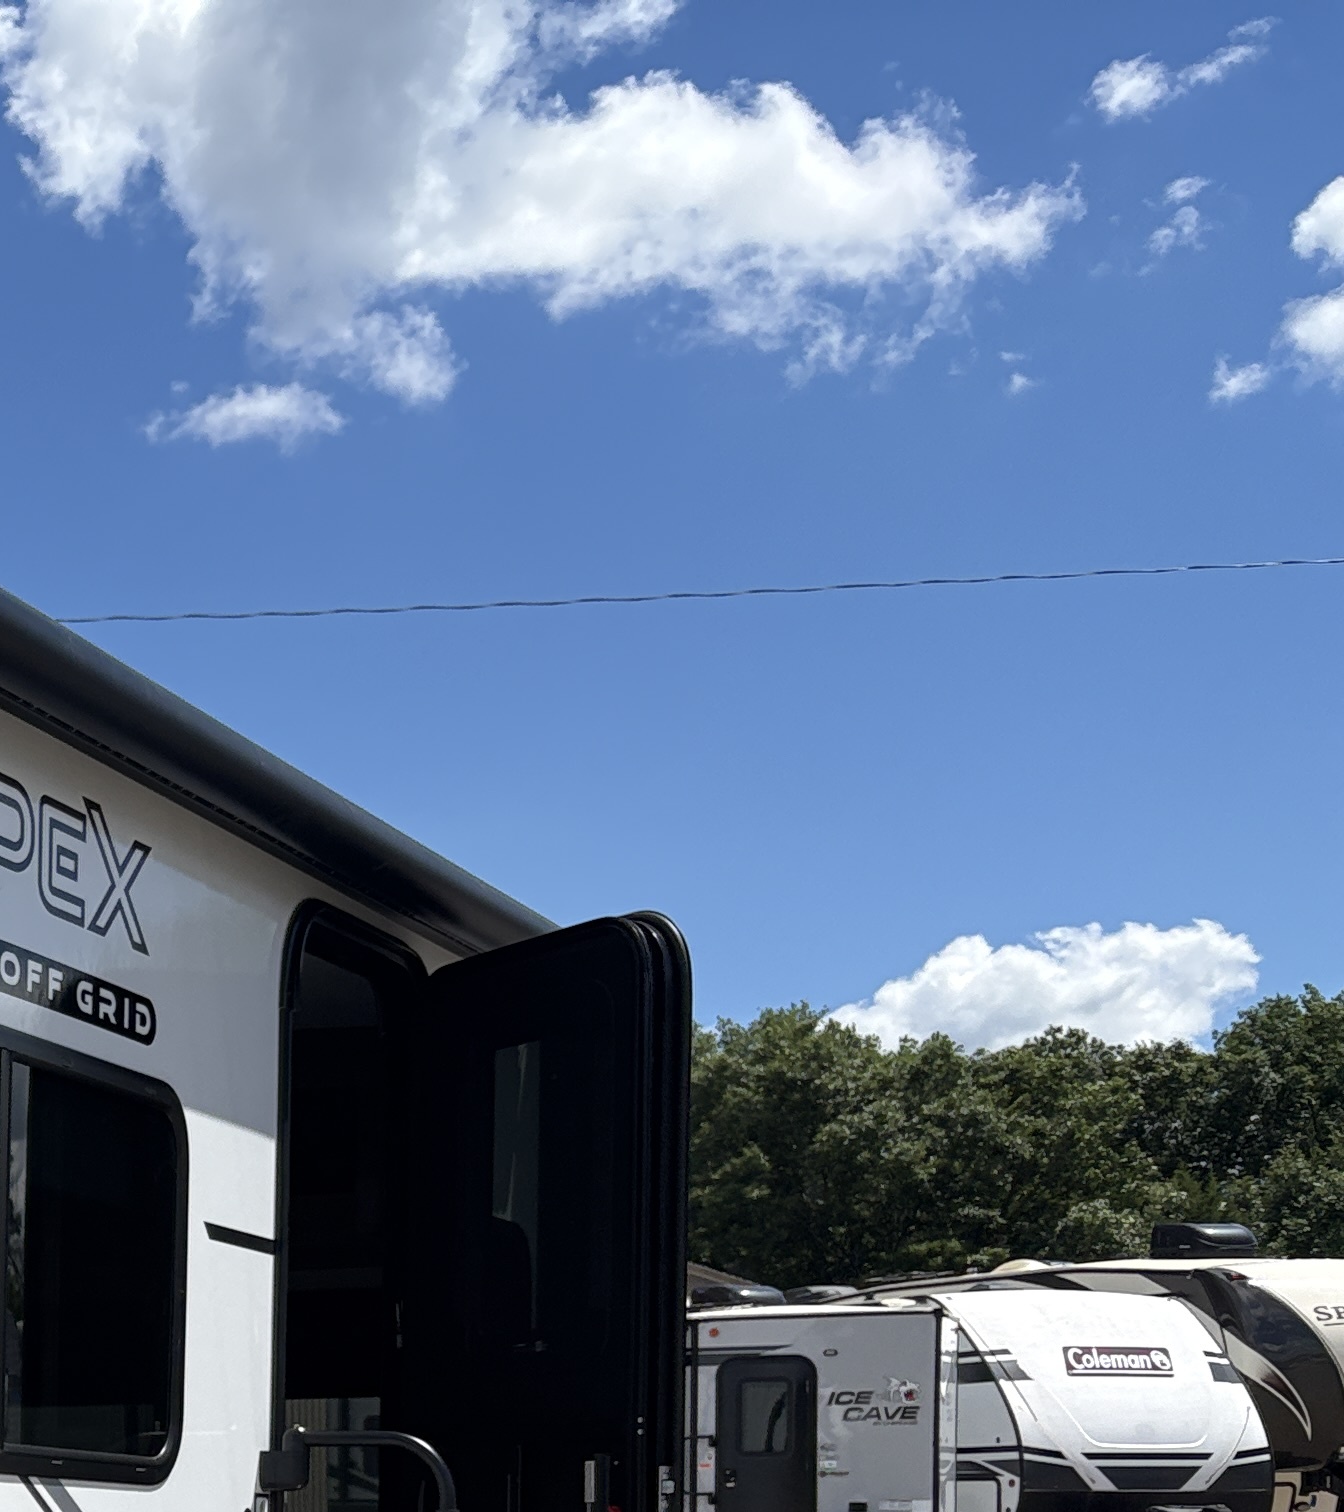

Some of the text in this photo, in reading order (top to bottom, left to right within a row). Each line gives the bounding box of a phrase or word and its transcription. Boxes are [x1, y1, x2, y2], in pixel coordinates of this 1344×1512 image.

[0, 950, 64, 1001] OFF
[75, 979, 153, 1036] GRID
[1067, 1346, 1152, 1370] Coleman
[826, 1390, 875, 1406] ICE
[842, 1405, 921, 1422] CAVE
